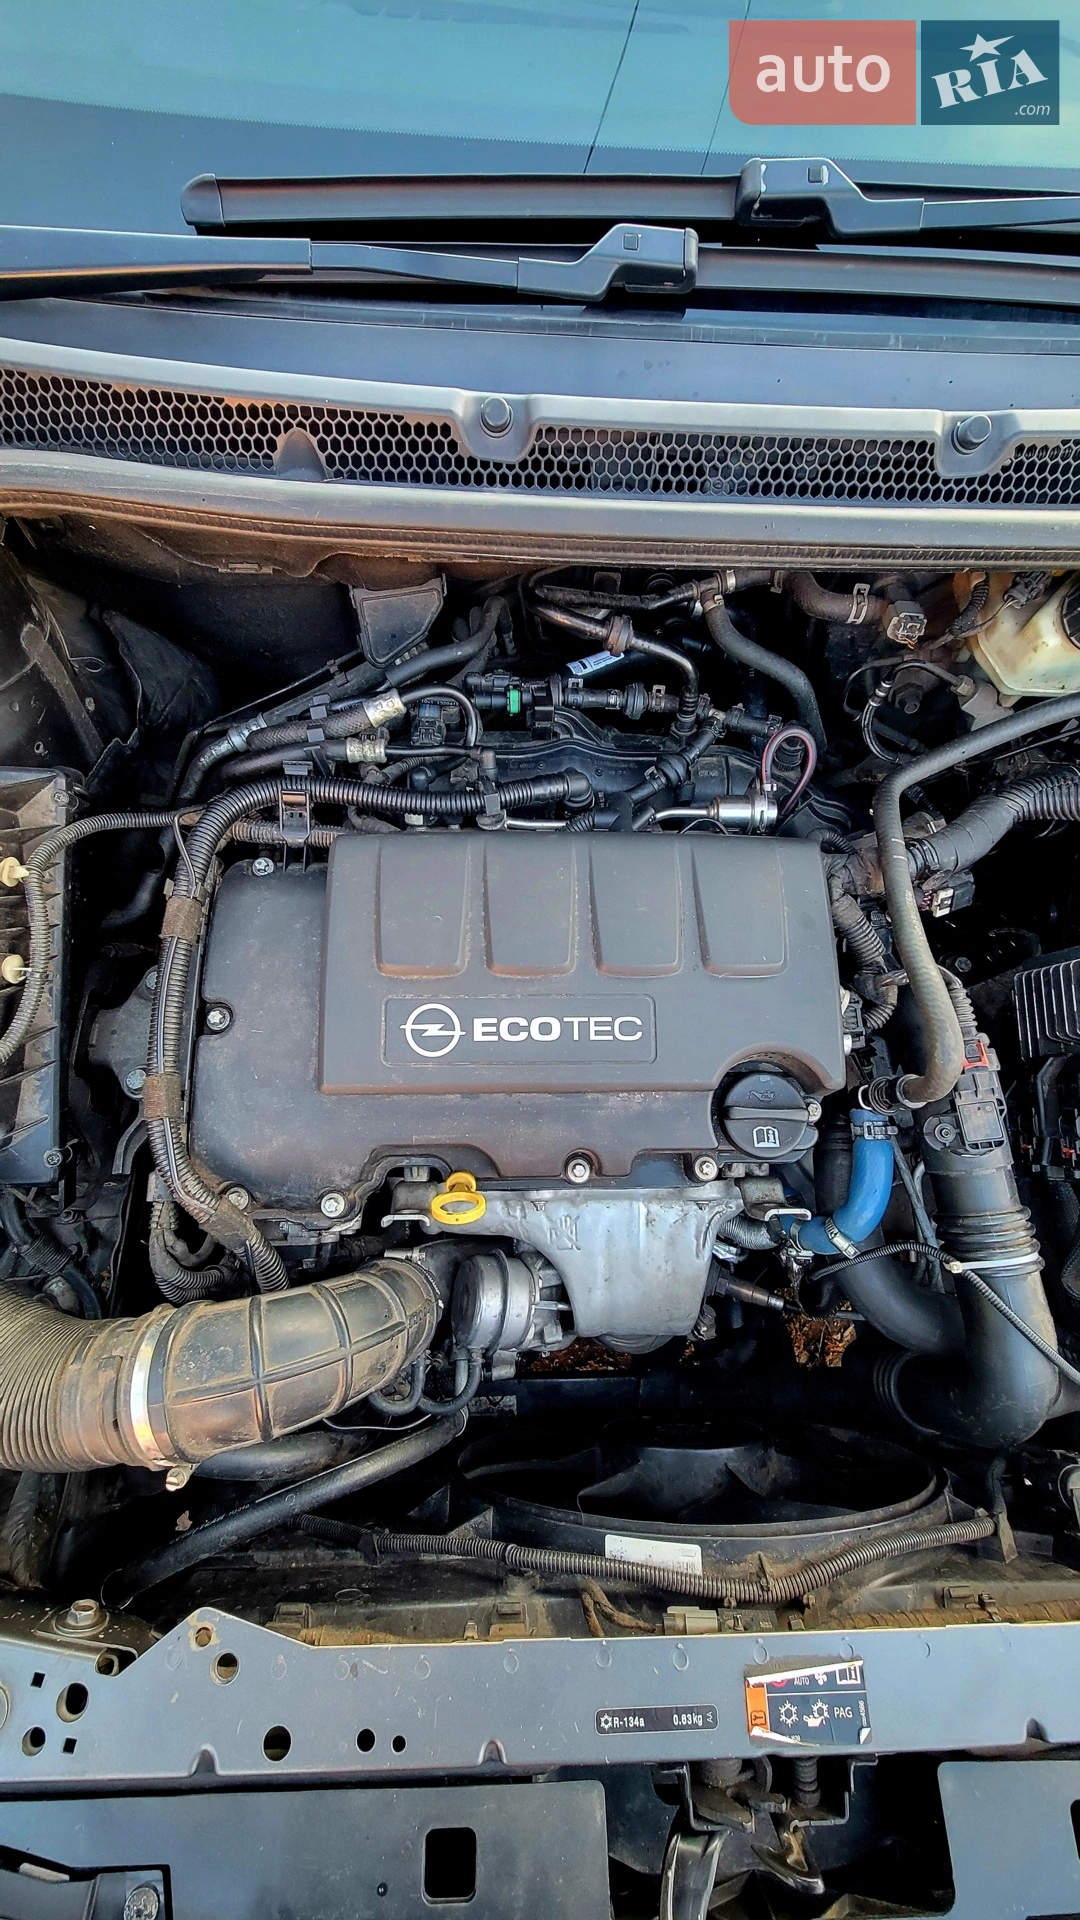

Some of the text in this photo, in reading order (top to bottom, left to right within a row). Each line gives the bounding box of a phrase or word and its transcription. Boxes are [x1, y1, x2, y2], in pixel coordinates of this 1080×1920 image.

[473, 1016, 643, 1042] ECOTEC
[834, 1707, 853, 1719] PAG
[613, 1716, 645, 1729] R-134a
